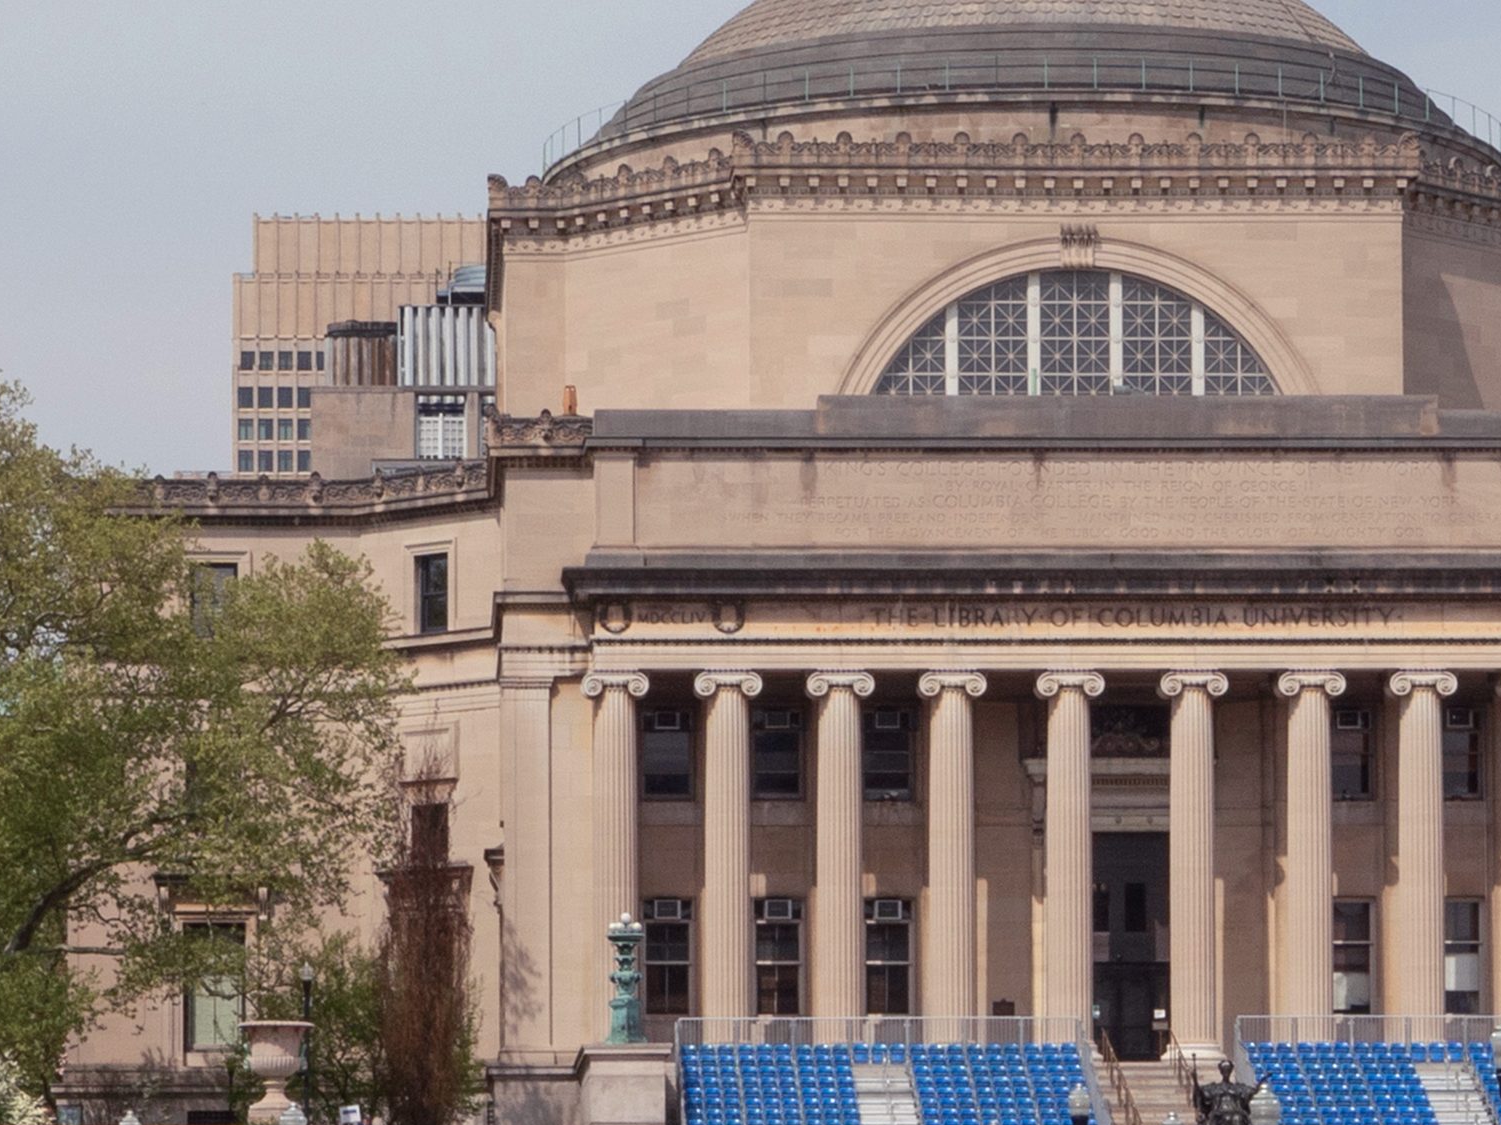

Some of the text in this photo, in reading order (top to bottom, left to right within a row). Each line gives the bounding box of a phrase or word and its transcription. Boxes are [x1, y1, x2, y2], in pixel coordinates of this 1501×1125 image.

[932, 494, 1022, 509] COLUMBIA
[637, 611, 706, 624] MDCCLIV
[869, 608, 1394, 627] THE LIBRARY OF COLUMBIA UNIVERSITY
